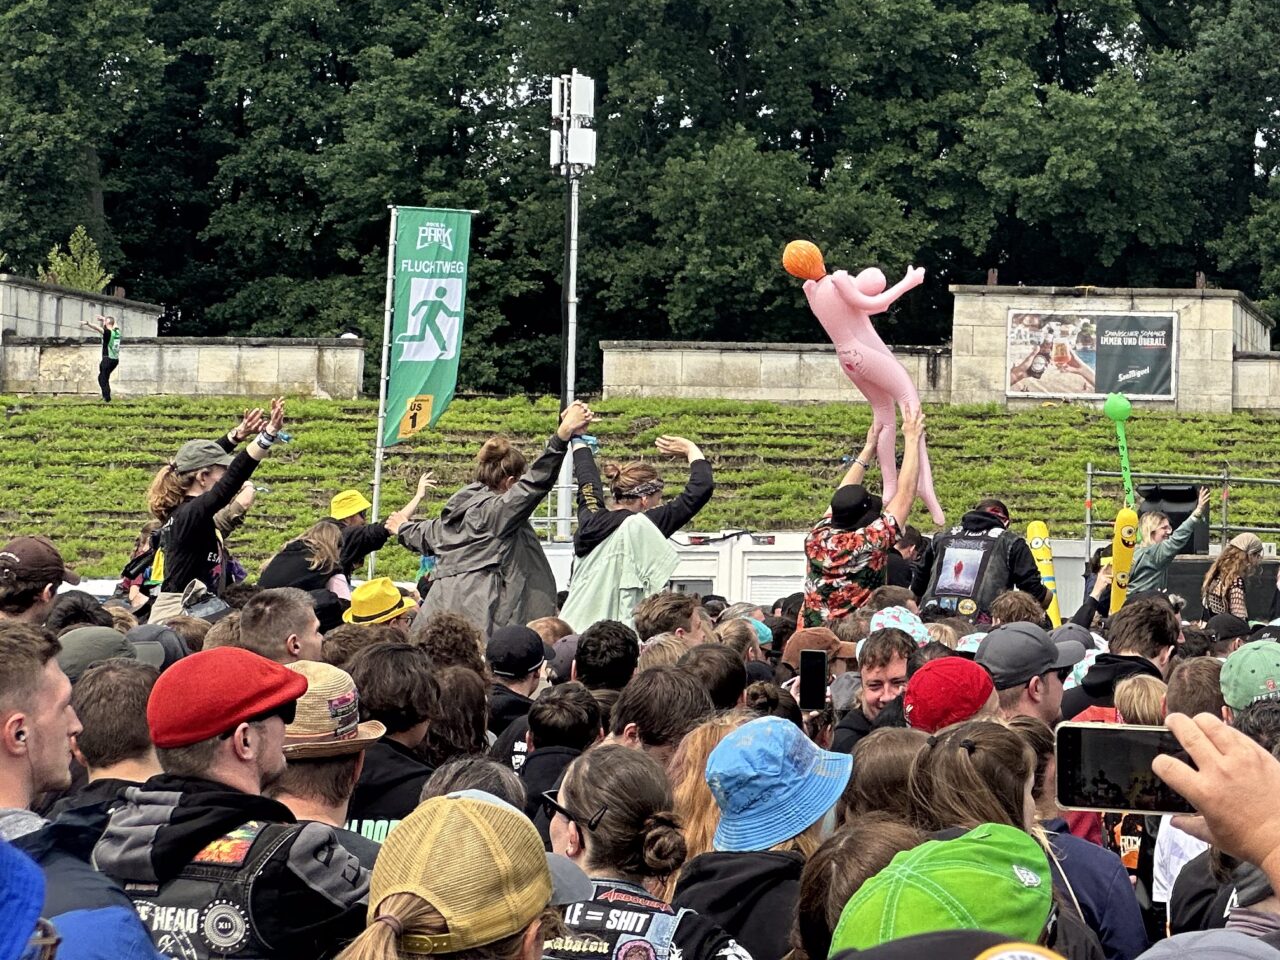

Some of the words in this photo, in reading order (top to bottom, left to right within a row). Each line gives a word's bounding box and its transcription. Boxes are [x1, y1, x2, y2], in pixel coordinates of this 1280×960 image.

[416, 226, 453, 251] PARK
[401, 259, 464, 273] FLUCHTWEG
[1101, 336, 1122, 345] IMMER
[1123, 337, 1137, 346] UND
[409, 412, 418, 429] 1
[152, 906, 199, 933] HEAD
[606, 909, 650, 933] SHIT
